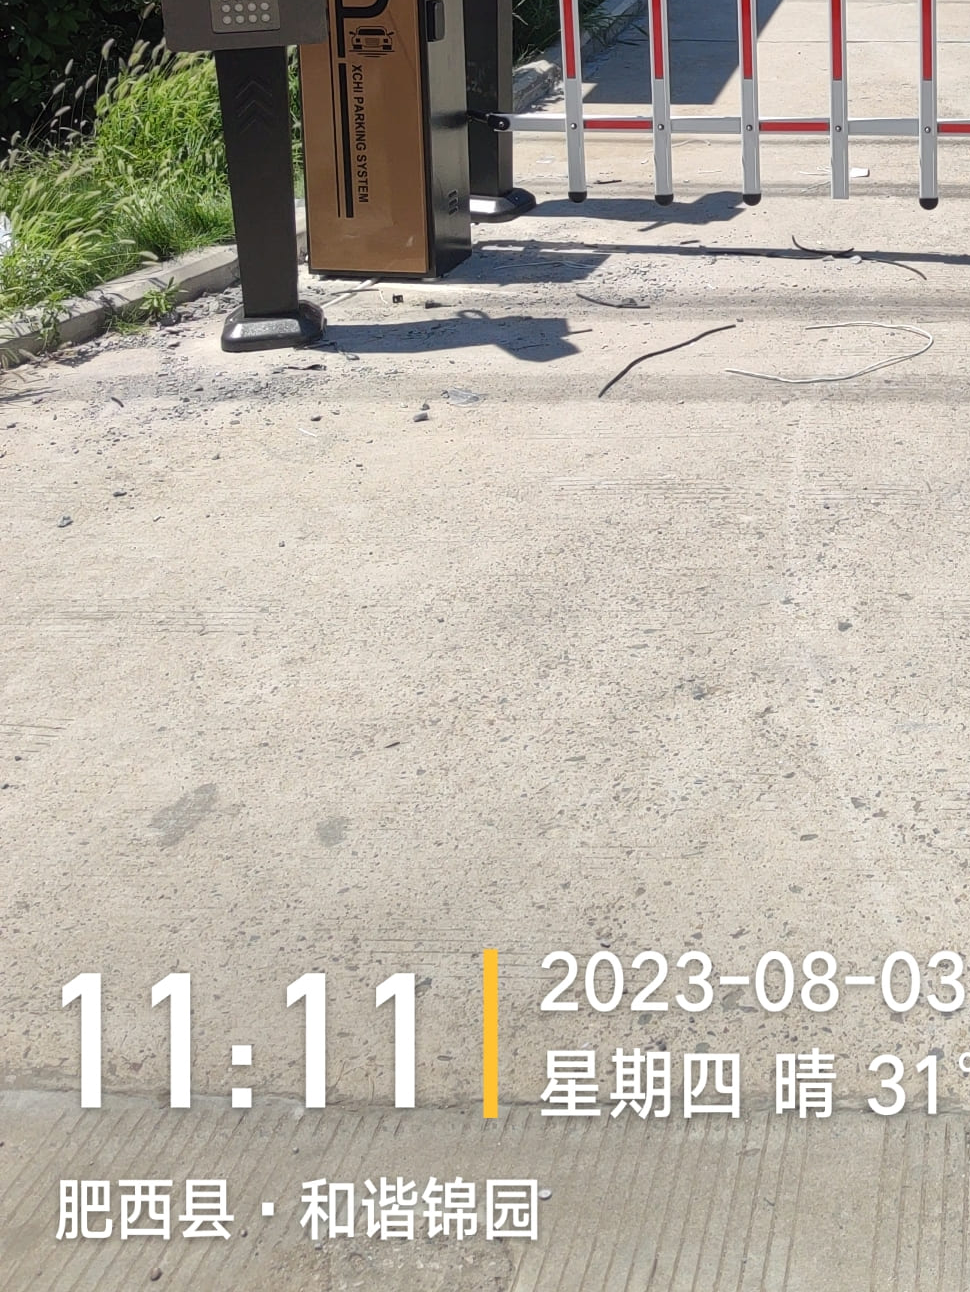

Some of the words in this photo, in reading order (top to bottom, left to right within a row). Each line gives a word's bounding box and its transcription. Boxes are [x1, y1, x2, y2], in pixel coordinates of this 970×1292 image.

[351, 64, 364, 93] XCHI
[352, 96, 367, 151] PARKING
[355, 154, 369, 203] SYSTEM
